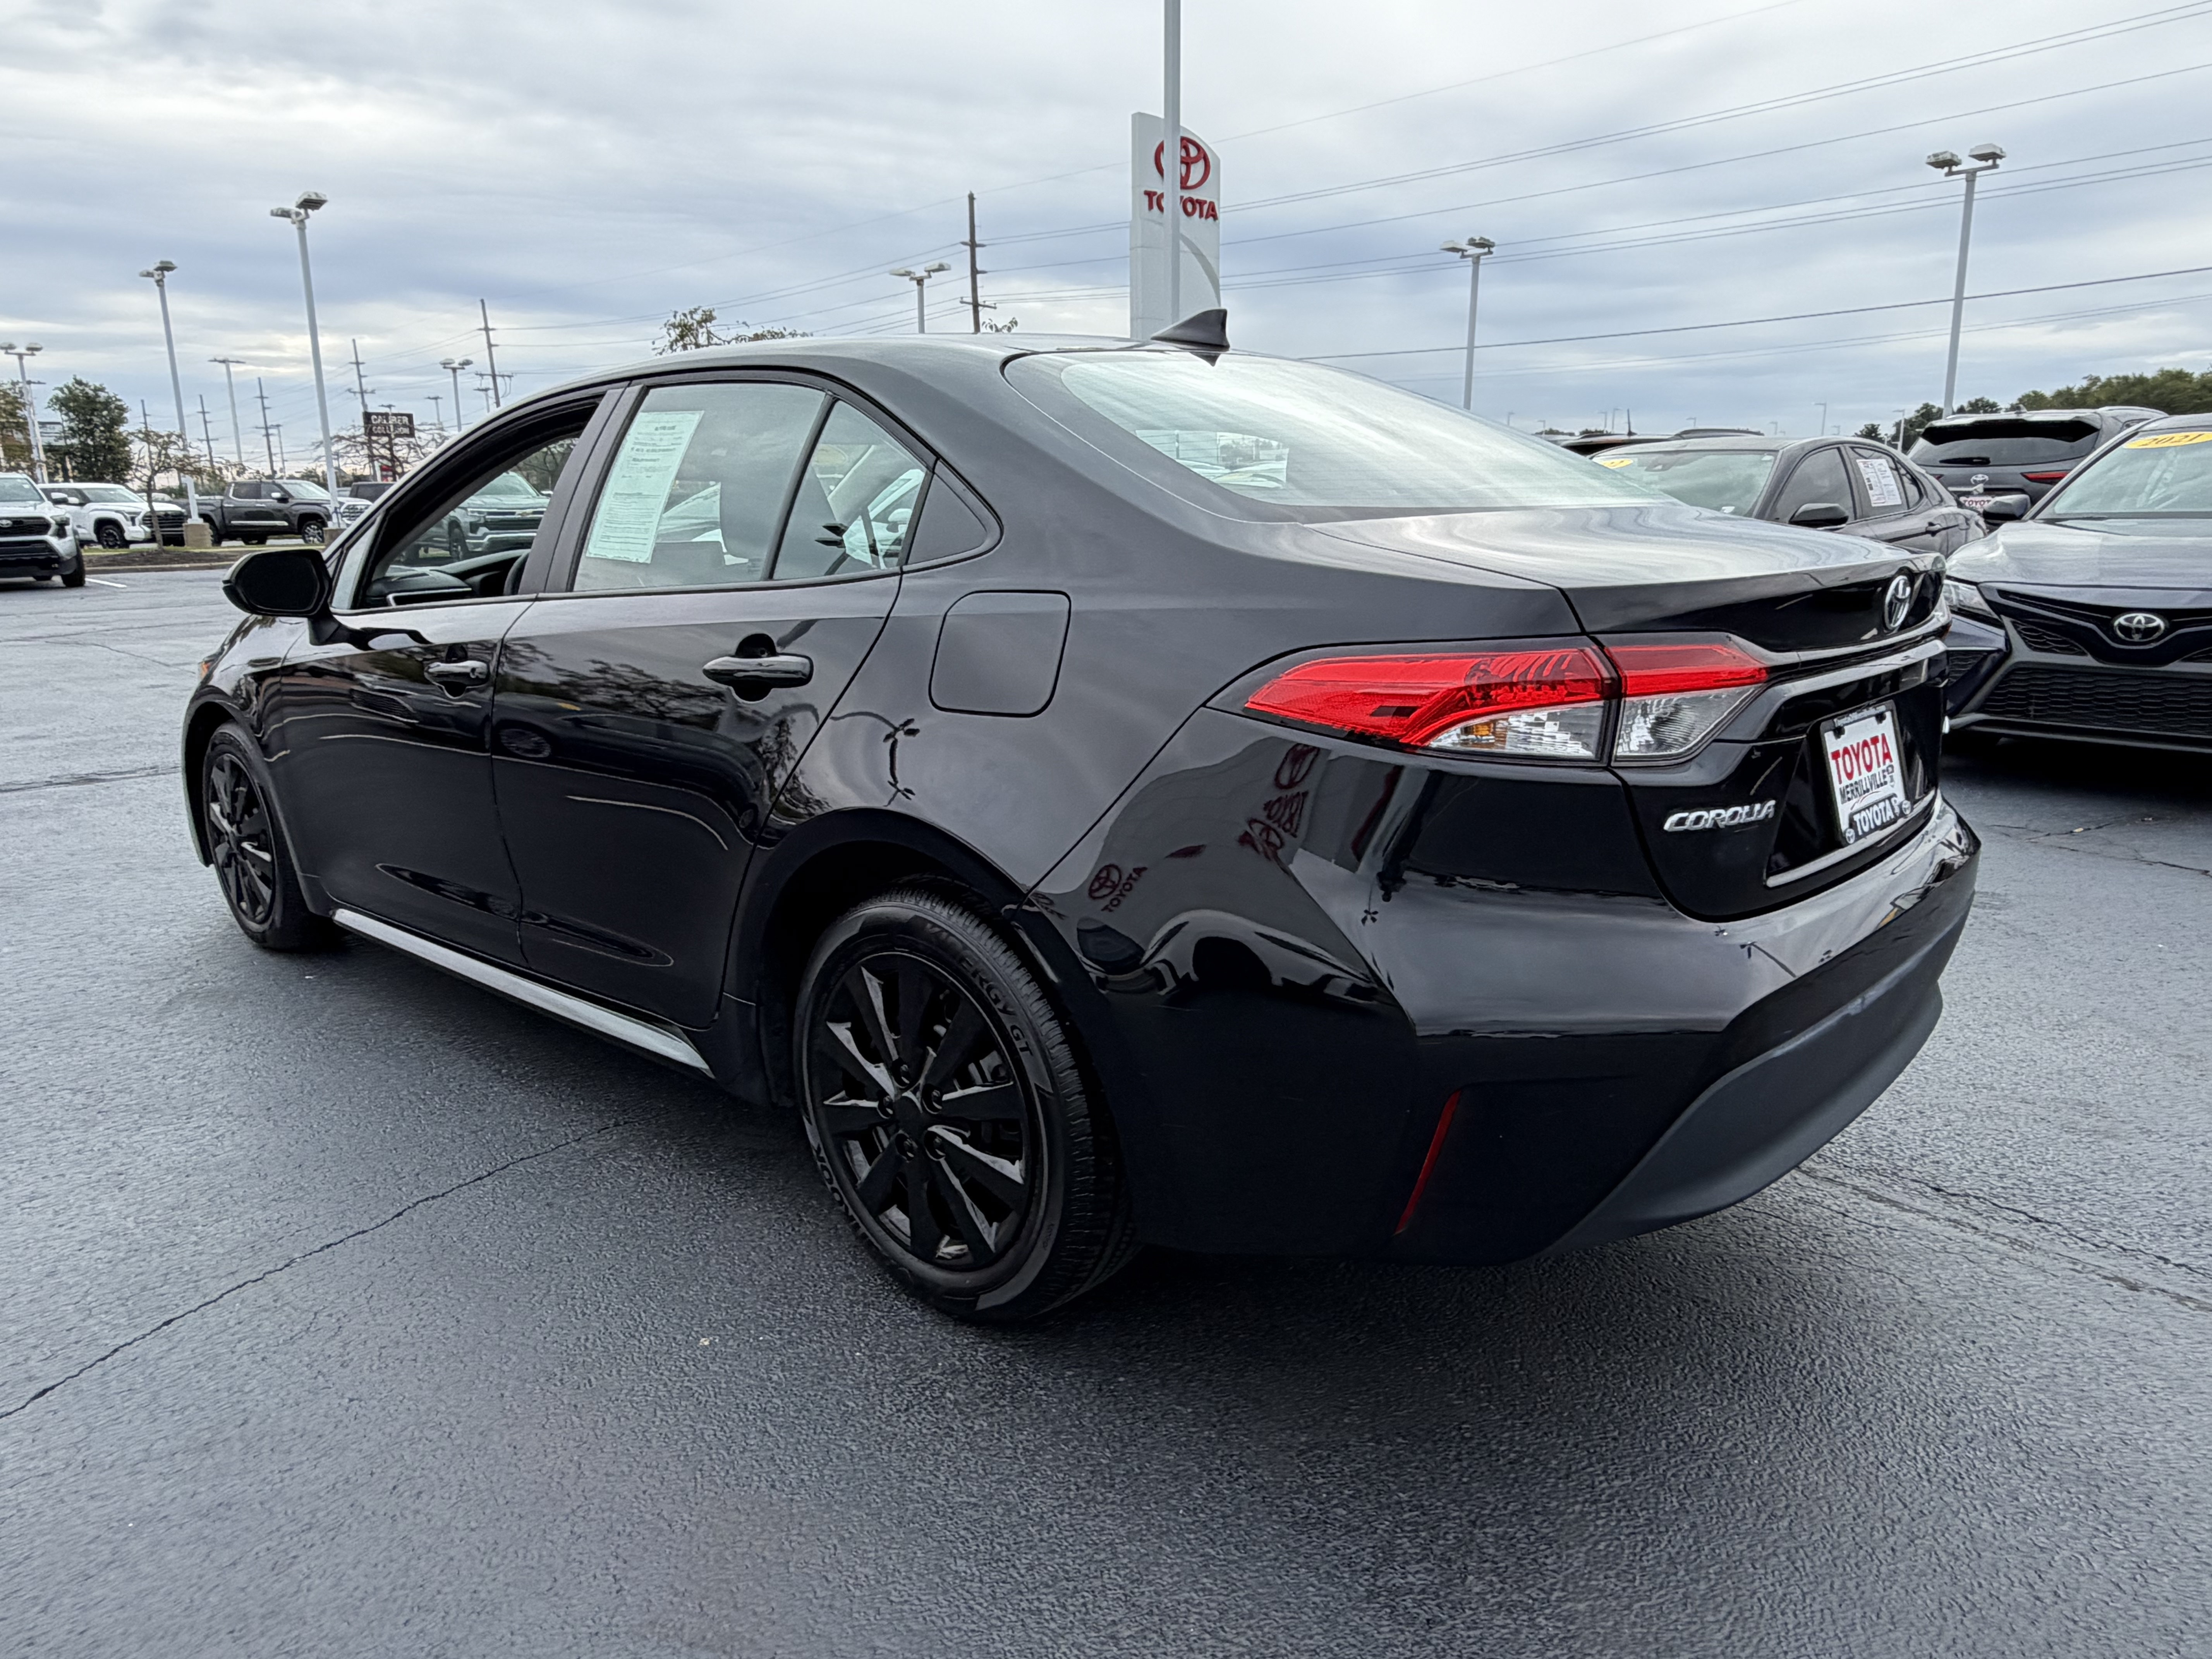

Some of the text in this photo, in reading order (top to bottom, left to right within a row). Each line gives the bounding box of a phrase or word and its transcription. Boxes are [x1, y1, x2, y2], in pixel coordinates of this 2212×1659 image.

[1144, 190, 1218, 221] TOOTA
[371, 415, 409, 424] CALBER
[2138, 433, 2204, 447] 2021
[1831, 733, 1893, 784] TOYOTA
[1839, 769, 1888, 804] MERRILLVILLE
[1663, 800, 1776, 831] COROLLA
[1853, 798, 1894, 836] TOYOTA
[1010, 1024, 1033, 1056] GT
